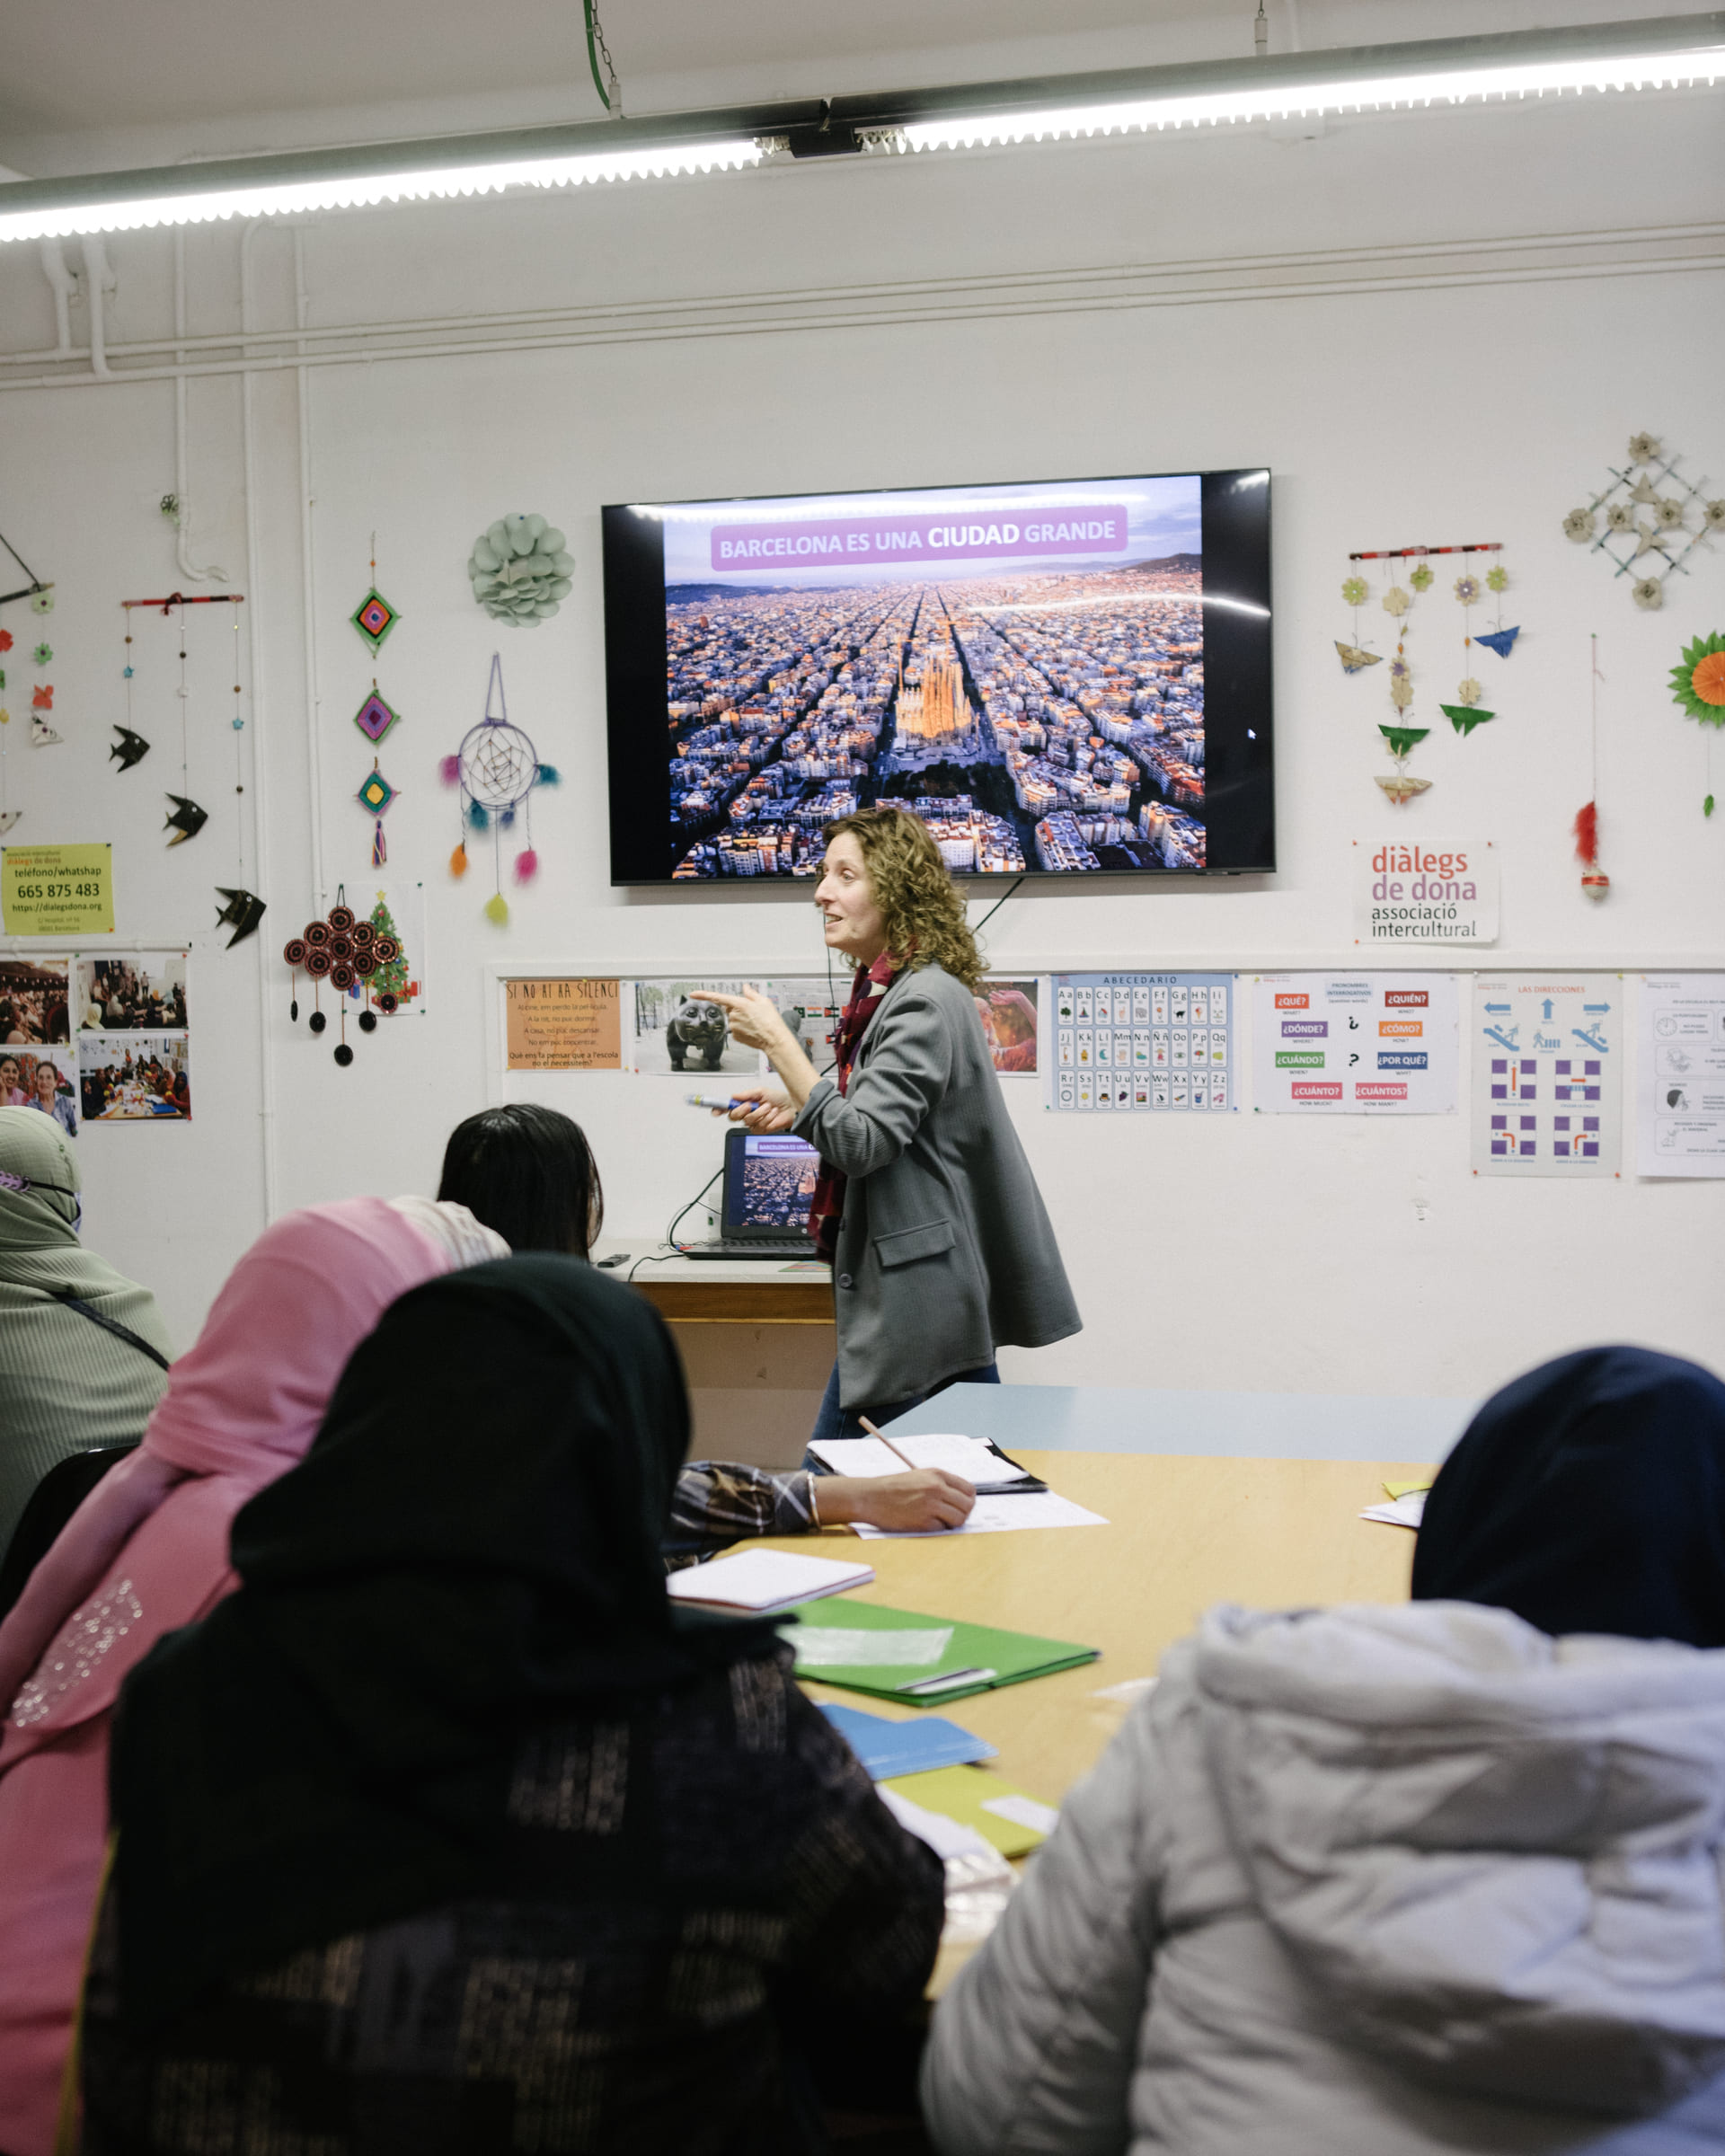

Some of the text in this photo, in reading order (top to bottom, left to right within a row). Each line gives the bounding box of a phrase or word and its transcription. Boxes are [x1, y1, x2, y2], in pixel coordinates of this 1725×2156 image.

[720, 520, 1117, 559] BARCELONA ES UNA CIUDAD GRANDE
[1372, 845, 1468, 880] diàlegs
[14, 866, 102, 879] teléfono/whatshap
[18, 882, 100, 898] 665 875 483
[1372, 874, 1477, 901] de dona
[12, 902, 102, 914] https://dialegsdona.org
[1371, 902, 1457, 920] associació
[1372, 920, 1477, 938] intercultural
[1103, 976, 1177, 985] ABECEDARIO
[507, 984, 517, 999] SI
[523, 984, 536, 999] NO
[577, 982, 618, 999] SILENCI
[1517, 985, 1586, 994] LAS DIRECCIONES
[1278, 996, 1306, 1006] ¿QUÉ?
[1387, 993, 1427, 1004] ¿QUIÉN?
[1283, 1023, 1324, 1035] ¿DÓNDE?
[1382, 1023, 1420, 1034] ¿CÓMO?
[546, 1052, 571, 1060] pensar
[1277, 1055, 1324, 1065] ¿CUÁNDO?
[1377, 1054, 1427, 1065] ¿POR QUÉ?
[1294, 1085, 1340, 1096] ¿CUÁNTO?
[1356, 1086, 1408, 1096] ¿CUÁNTOS?
